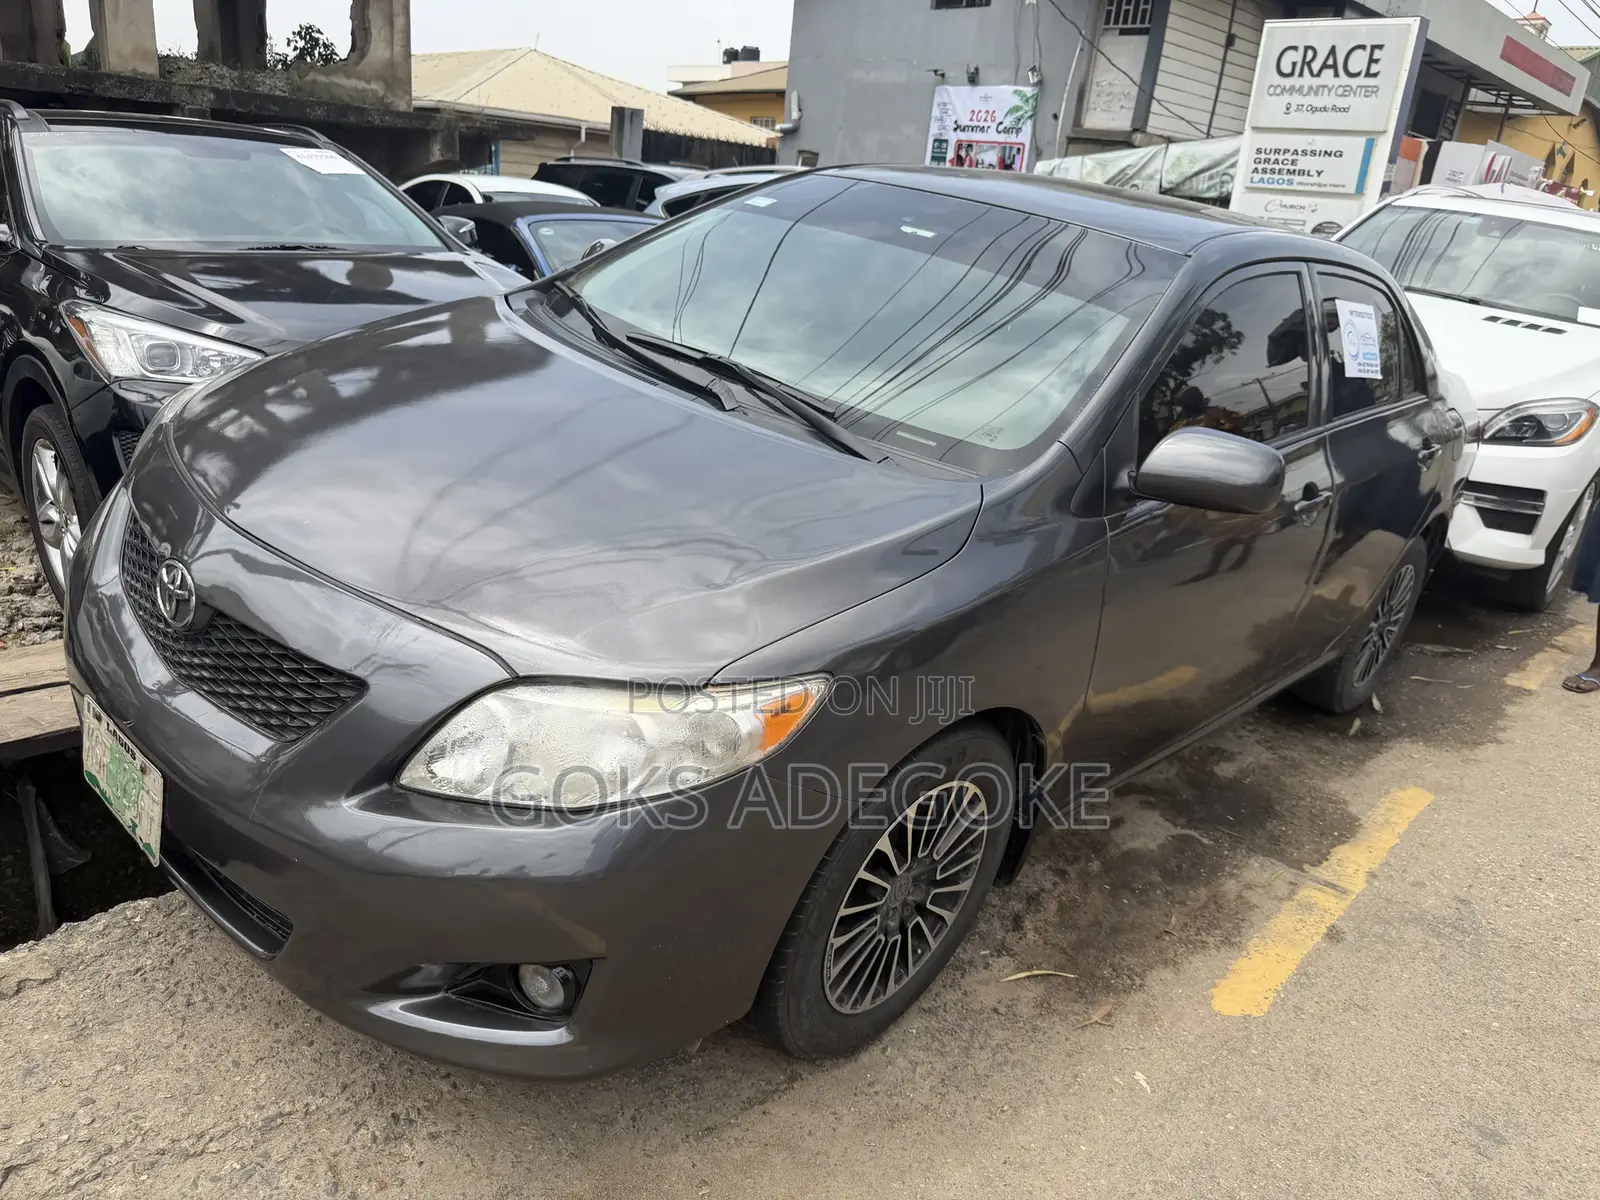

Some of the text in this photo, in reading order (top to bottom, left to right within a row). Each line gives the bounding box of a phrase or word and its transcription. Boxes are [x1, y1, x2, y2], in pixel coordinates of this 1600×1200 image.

[1275, 44, 1385, 78] GRACE
[1266, 84, 1380, 98] COMMUNITY CENTER
[1294, 104, 1351, 115] 37, Ogudu Road
[968, 109, 997, 123] 2026
[952, 120, 991, 135] Summer
[1255, 147, 1344, 158] SURPASSING
[1253, 157, 1300, 167] GRACE
[1251, 167, 1325, 178] ASSEMBLY
[1249, 177, 1295, 186] LAGOS
[106, 721, 138, 762] LAGOS
